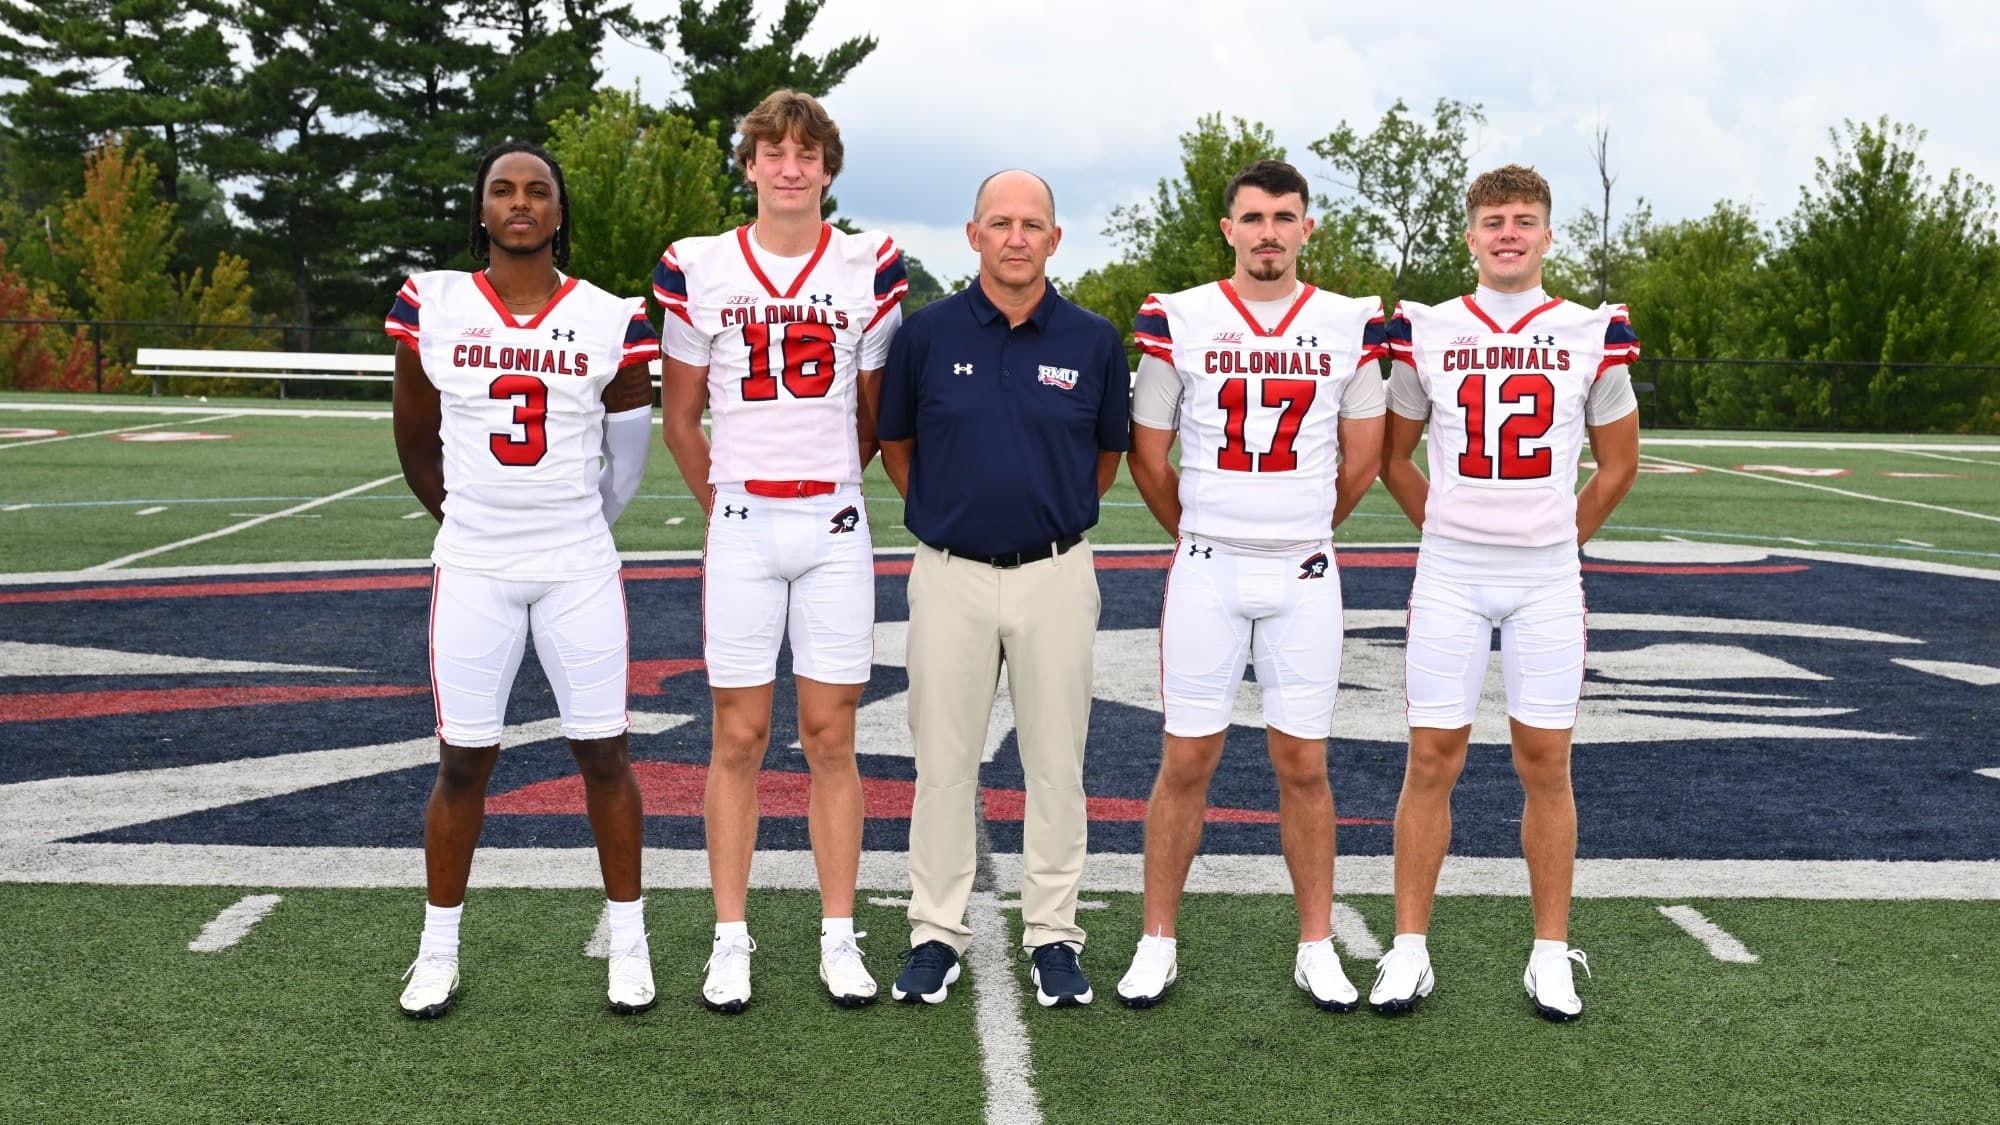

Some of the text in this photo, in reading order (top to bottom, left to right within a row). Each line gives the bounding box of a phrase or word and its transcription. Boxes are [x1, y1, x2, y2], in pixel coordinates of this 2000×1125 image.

[720, 305, 848, 330] COLONIALS
[453, 344, 589, 376] COLONIALS
[741, 322, 836, 401] 16
[1038, 364, 1079, 384] RMU
[1204, 350, 1331, 377] COLONIALS
[1443, 346, 1570, 372] COLONIALS
[489, 374, 548, 466] 3
[1217, 377, 1317, 473] 17
[1456, 373, 1555, 480] 12
